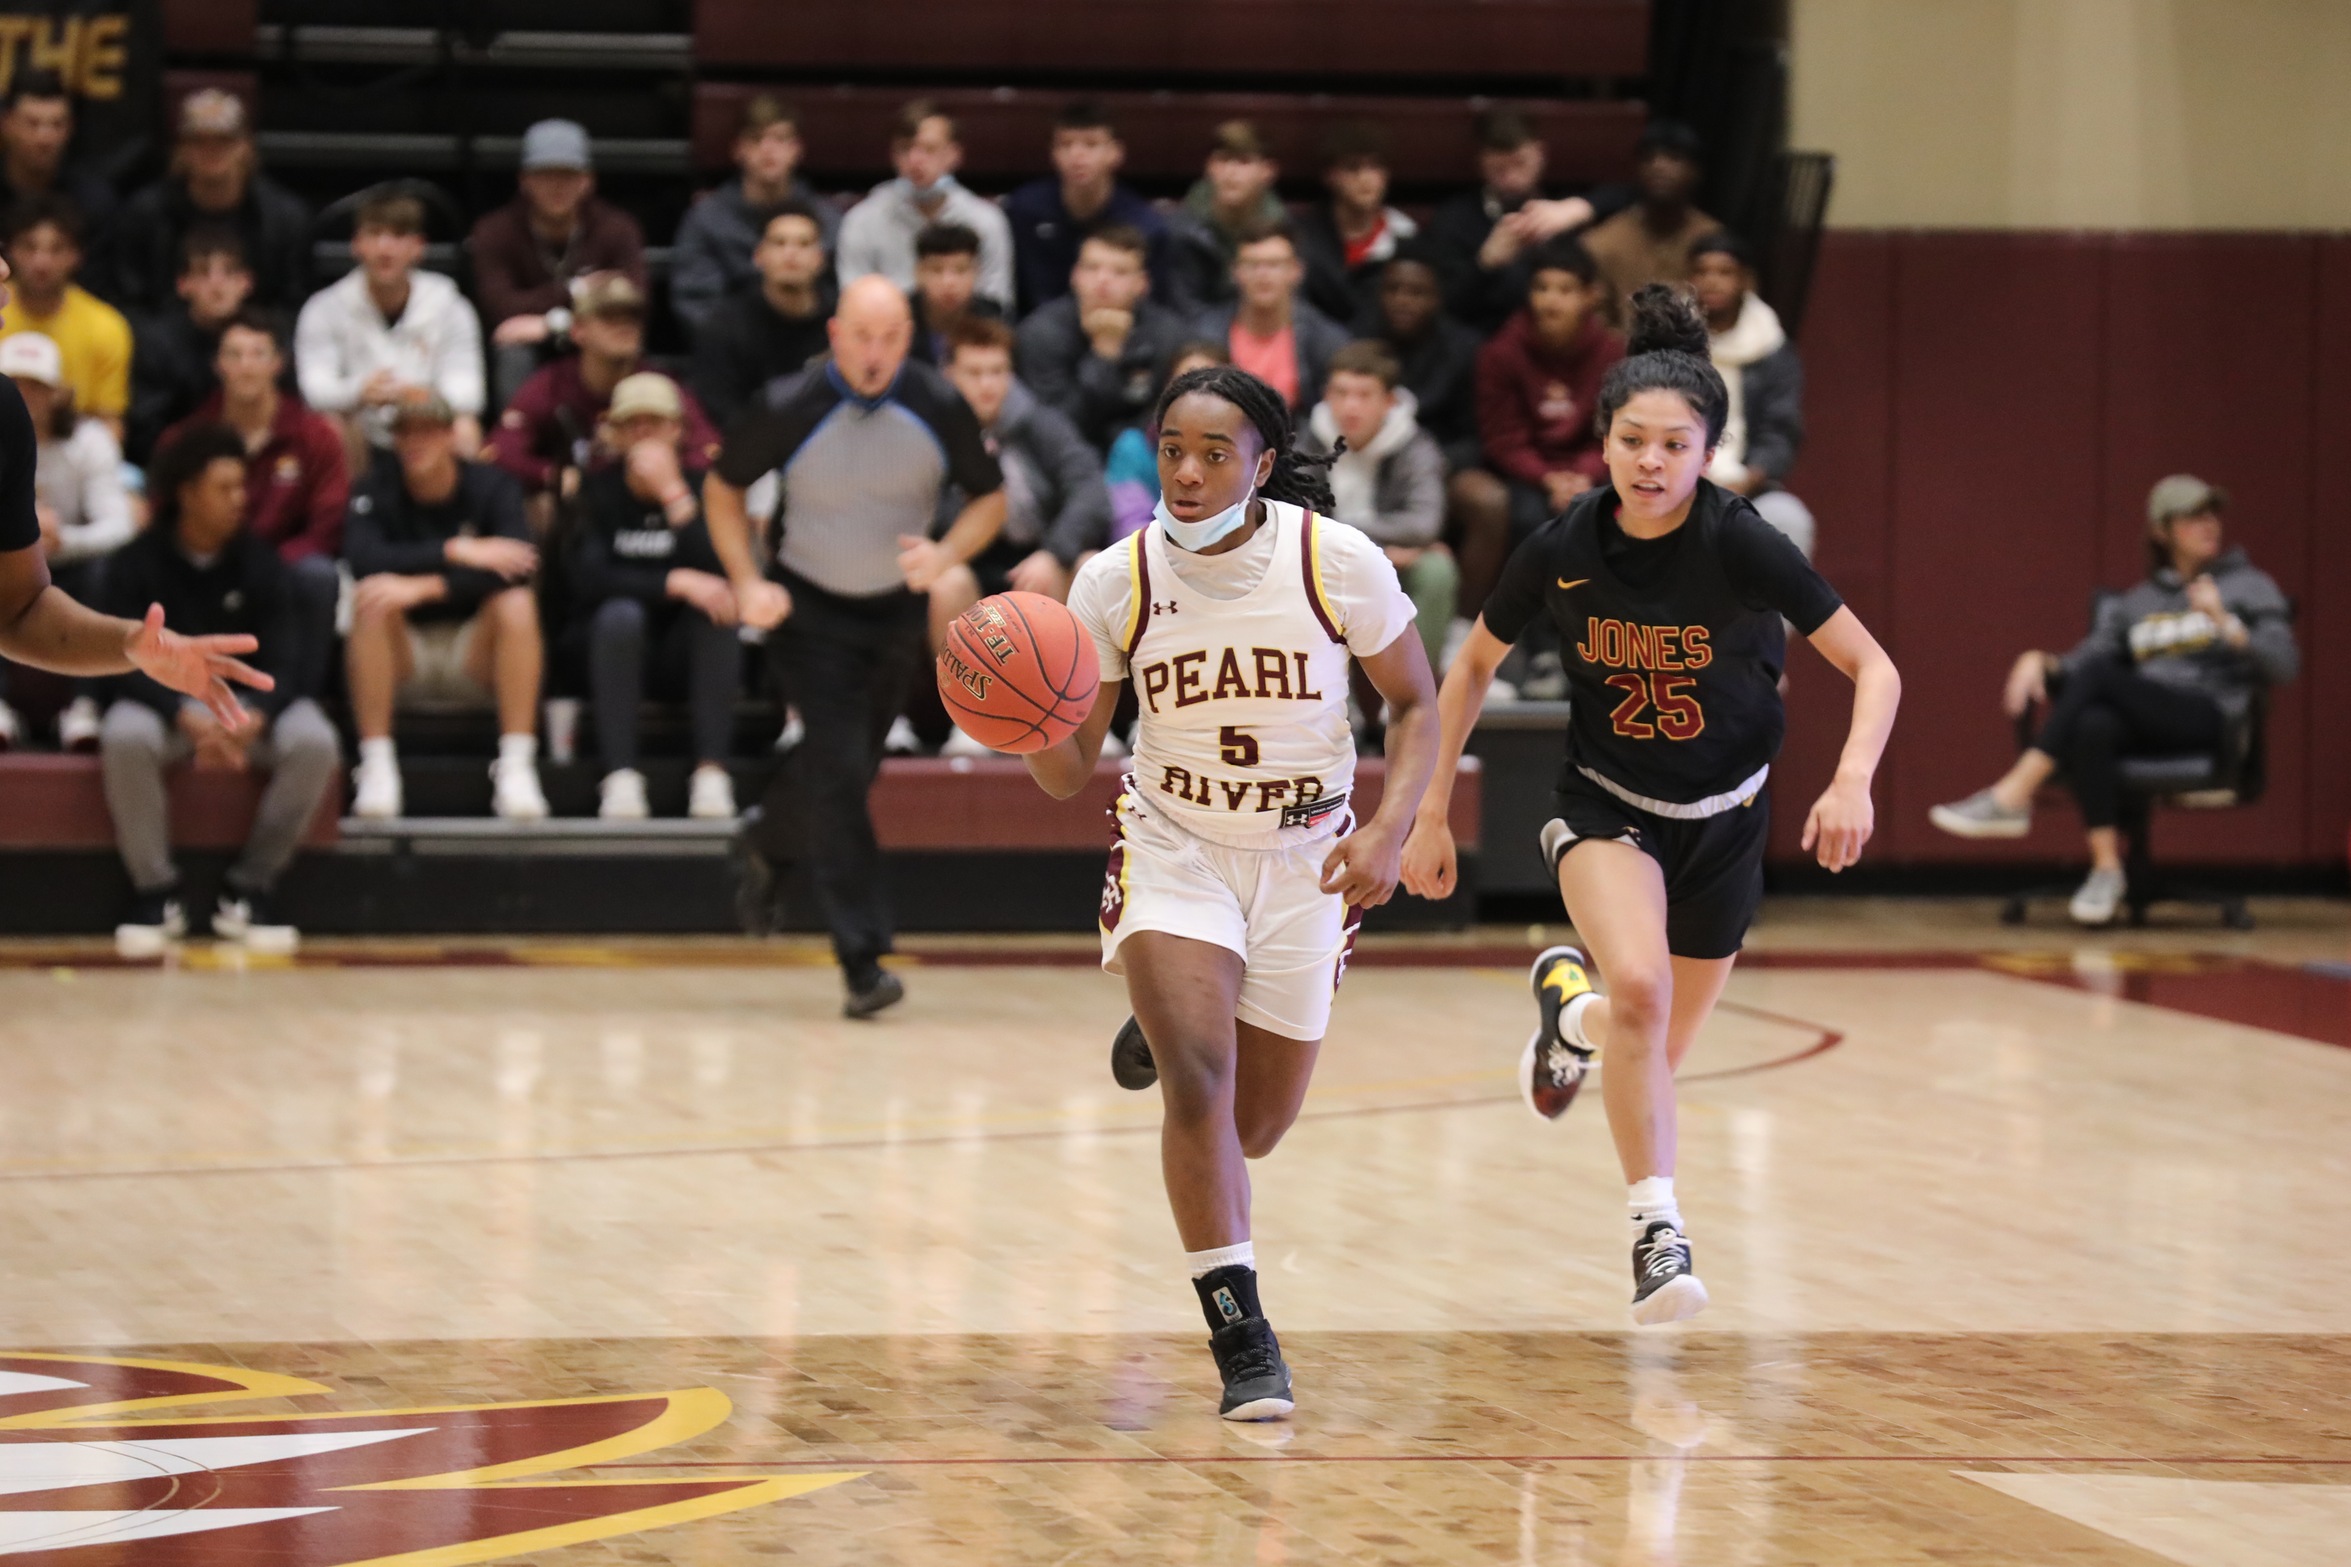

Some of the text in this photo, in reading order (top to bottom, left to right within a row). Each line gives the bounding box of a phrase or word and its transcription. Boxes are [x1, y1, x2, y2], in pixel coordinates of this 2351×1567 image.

[1576, 616, 1713, 670] JONES
[941, 643, 993, 701] SPALD
[1141, 646, 1323, 714] PEARL
[1603, 671, 1706, 741] 25
[1218, 724, 1261, 767] 5
[1159, 765, 1324, 813] RIVER
